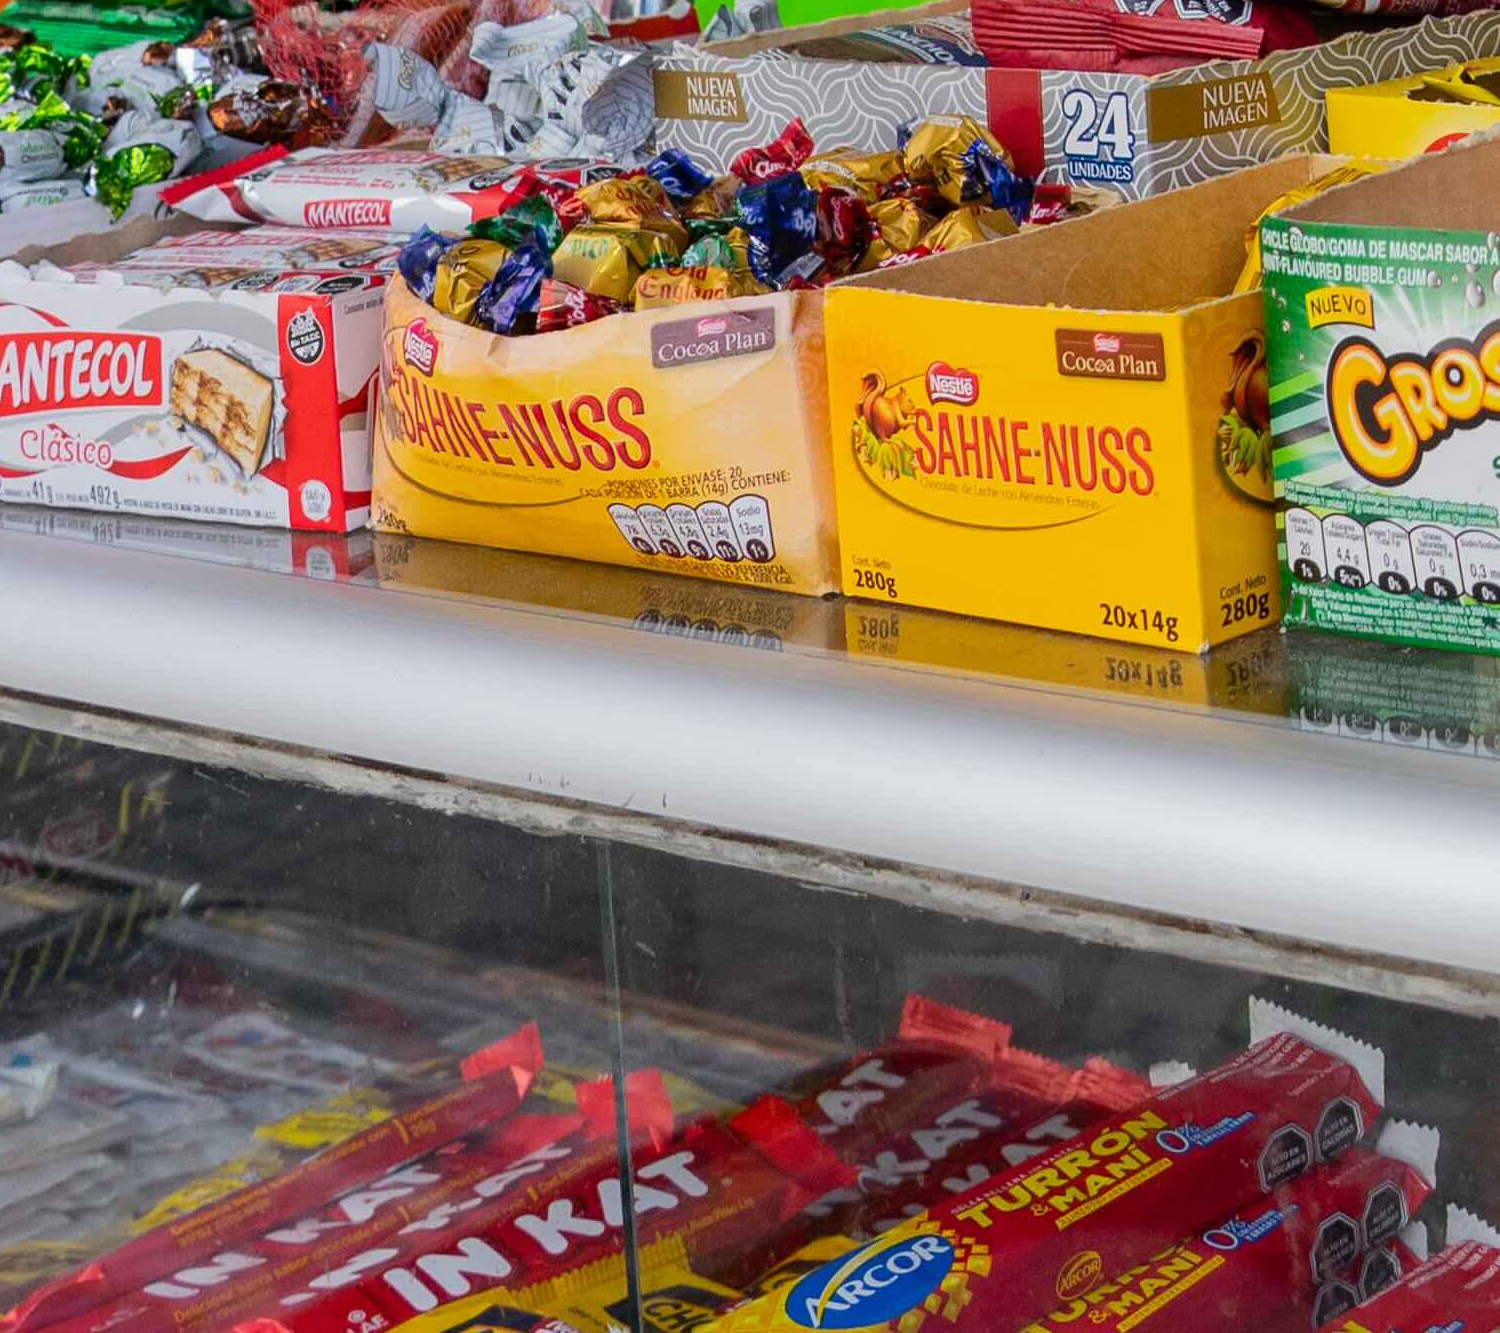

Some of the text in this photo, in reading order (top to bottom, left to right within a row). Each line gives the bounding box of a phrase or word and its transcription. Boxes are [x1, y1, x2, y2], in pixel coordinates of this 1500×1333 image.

[686, 77, 736, 100] NUEVA
[1203, 78, 1268, 109] NUEVA
[686, 95, 739, 119] IMAGEN
[1203, 100, 1269, 130] IMAGEN
[1062, 88, 1136, 161] 24
[1068, 160, 1133, 181] UNIDADES
[307, 201, 390, 226] MANTECOL
[1369, 240, 1387, 260] DE
[1389, 241, 1443, 262] MASCAR
[1446, 243, 1487, 265] SABOR
[1343, 262, 1428, 287] BUBBLE GUM
[1308, 295, 1369, 319] NUEVO
[658, 327, 767, 363] Cocoa Plan
[1061, 351, 1158, 376] Cocoa Plan
[929, 375, 974, 398] Nestlé
[399, 386, 652, 472] SAHNE-NUSS
[20, 423, 112, 467] Clásico
[914, 408, 1154, 497] SAHNE-NUSS
[731, 469, 792, 491] CONTIENE:
[736, 506, 761, 519] Sodio
[855, 569, 898, 599] 280g
[1100, 603, 1179, 642] 20x14g
[1220, 592, 1270, 630] 280g
[956, 1110, 1169, 1230] TURRÓN
[1050, 1145, 1153, 1214] MANÍ
[801, 1229, 952, 1328] ARCOR
[1106, 1250, 1204, 1318] MANÍ
